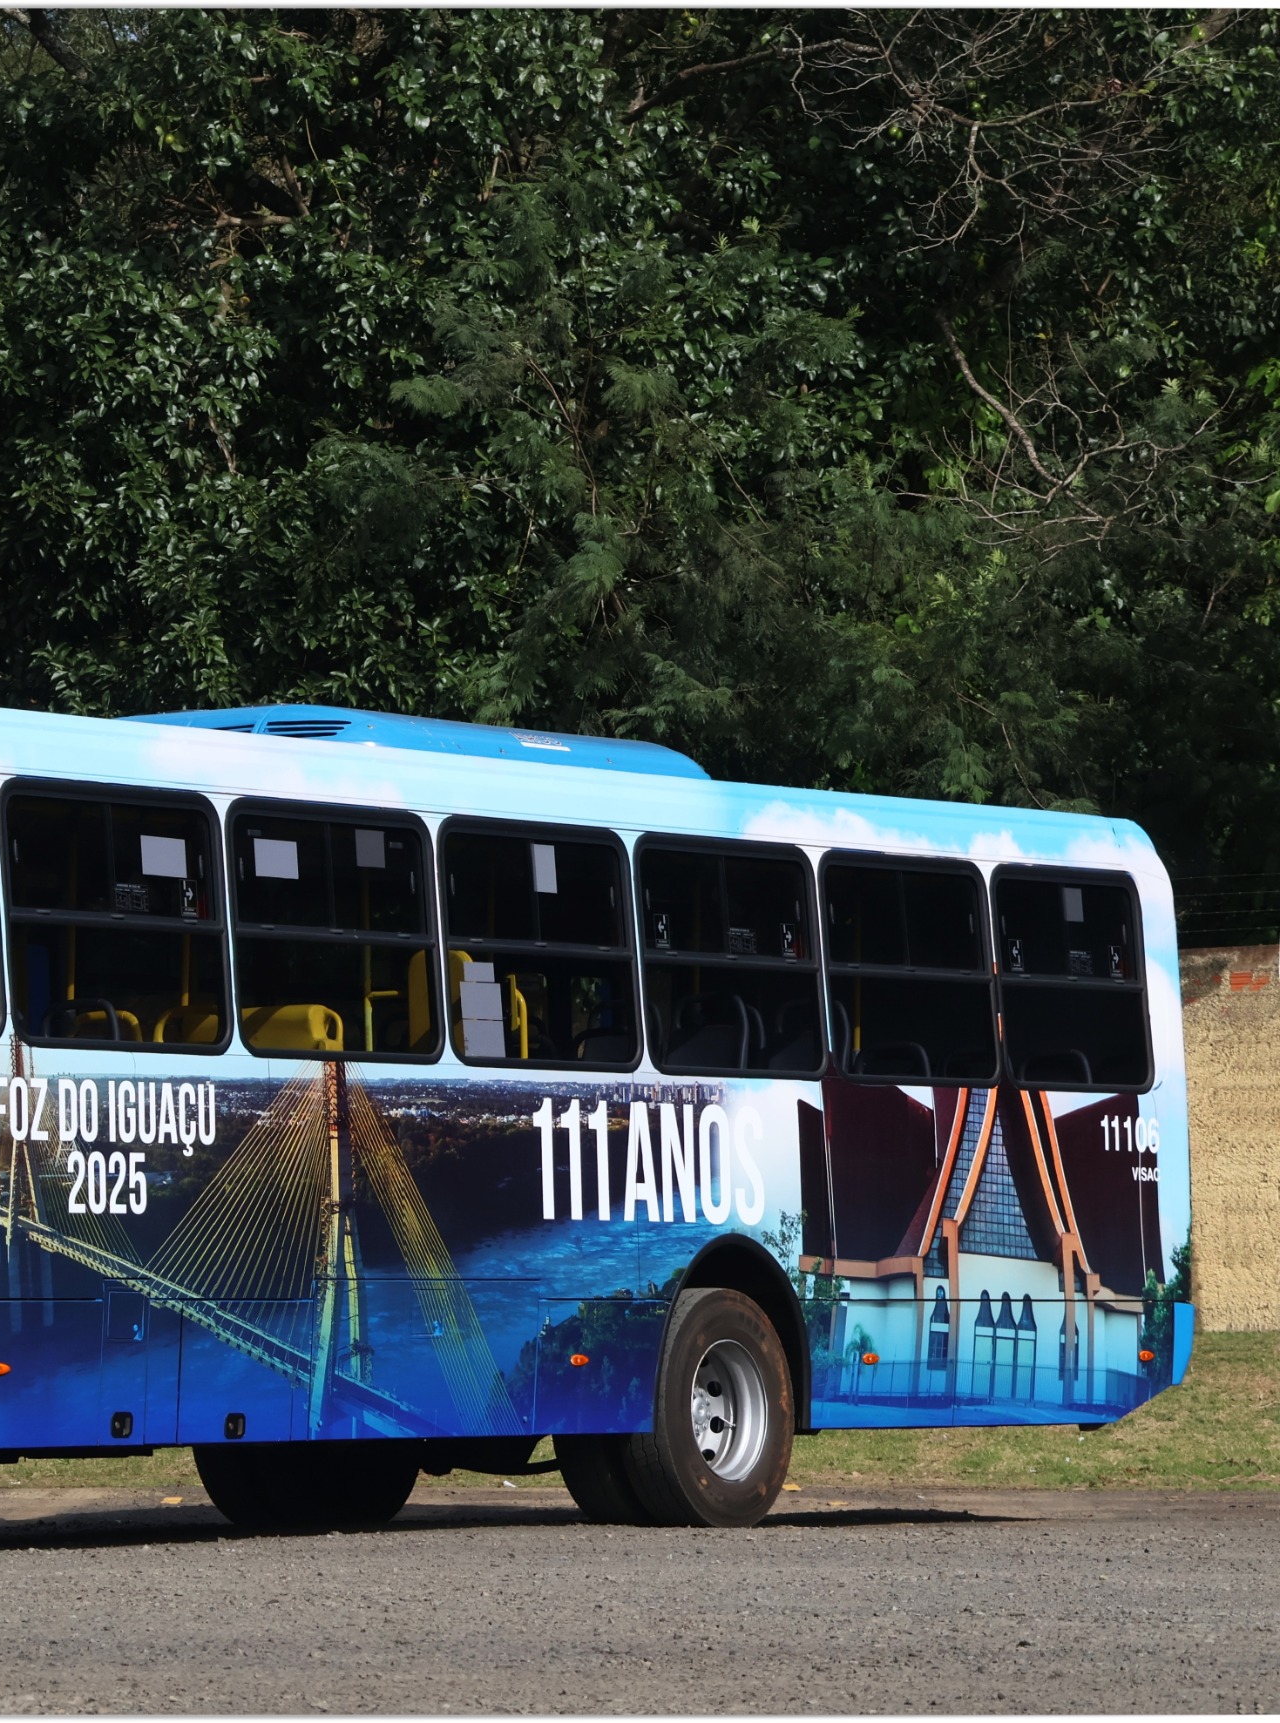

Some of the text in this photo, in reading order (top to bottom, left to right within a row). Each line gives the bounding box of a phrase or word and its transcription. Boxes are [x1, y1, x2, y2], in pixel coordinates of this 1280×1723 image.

[58, 1079, 99, 1143] DO
[1100, 1114, 1160, 1154] 11106
[67, 1151, 148, 1215] 2025
[532, 1097, 766, 1226] 111 ANOS
[1131, 1166, 1161, 1182] VISAC
